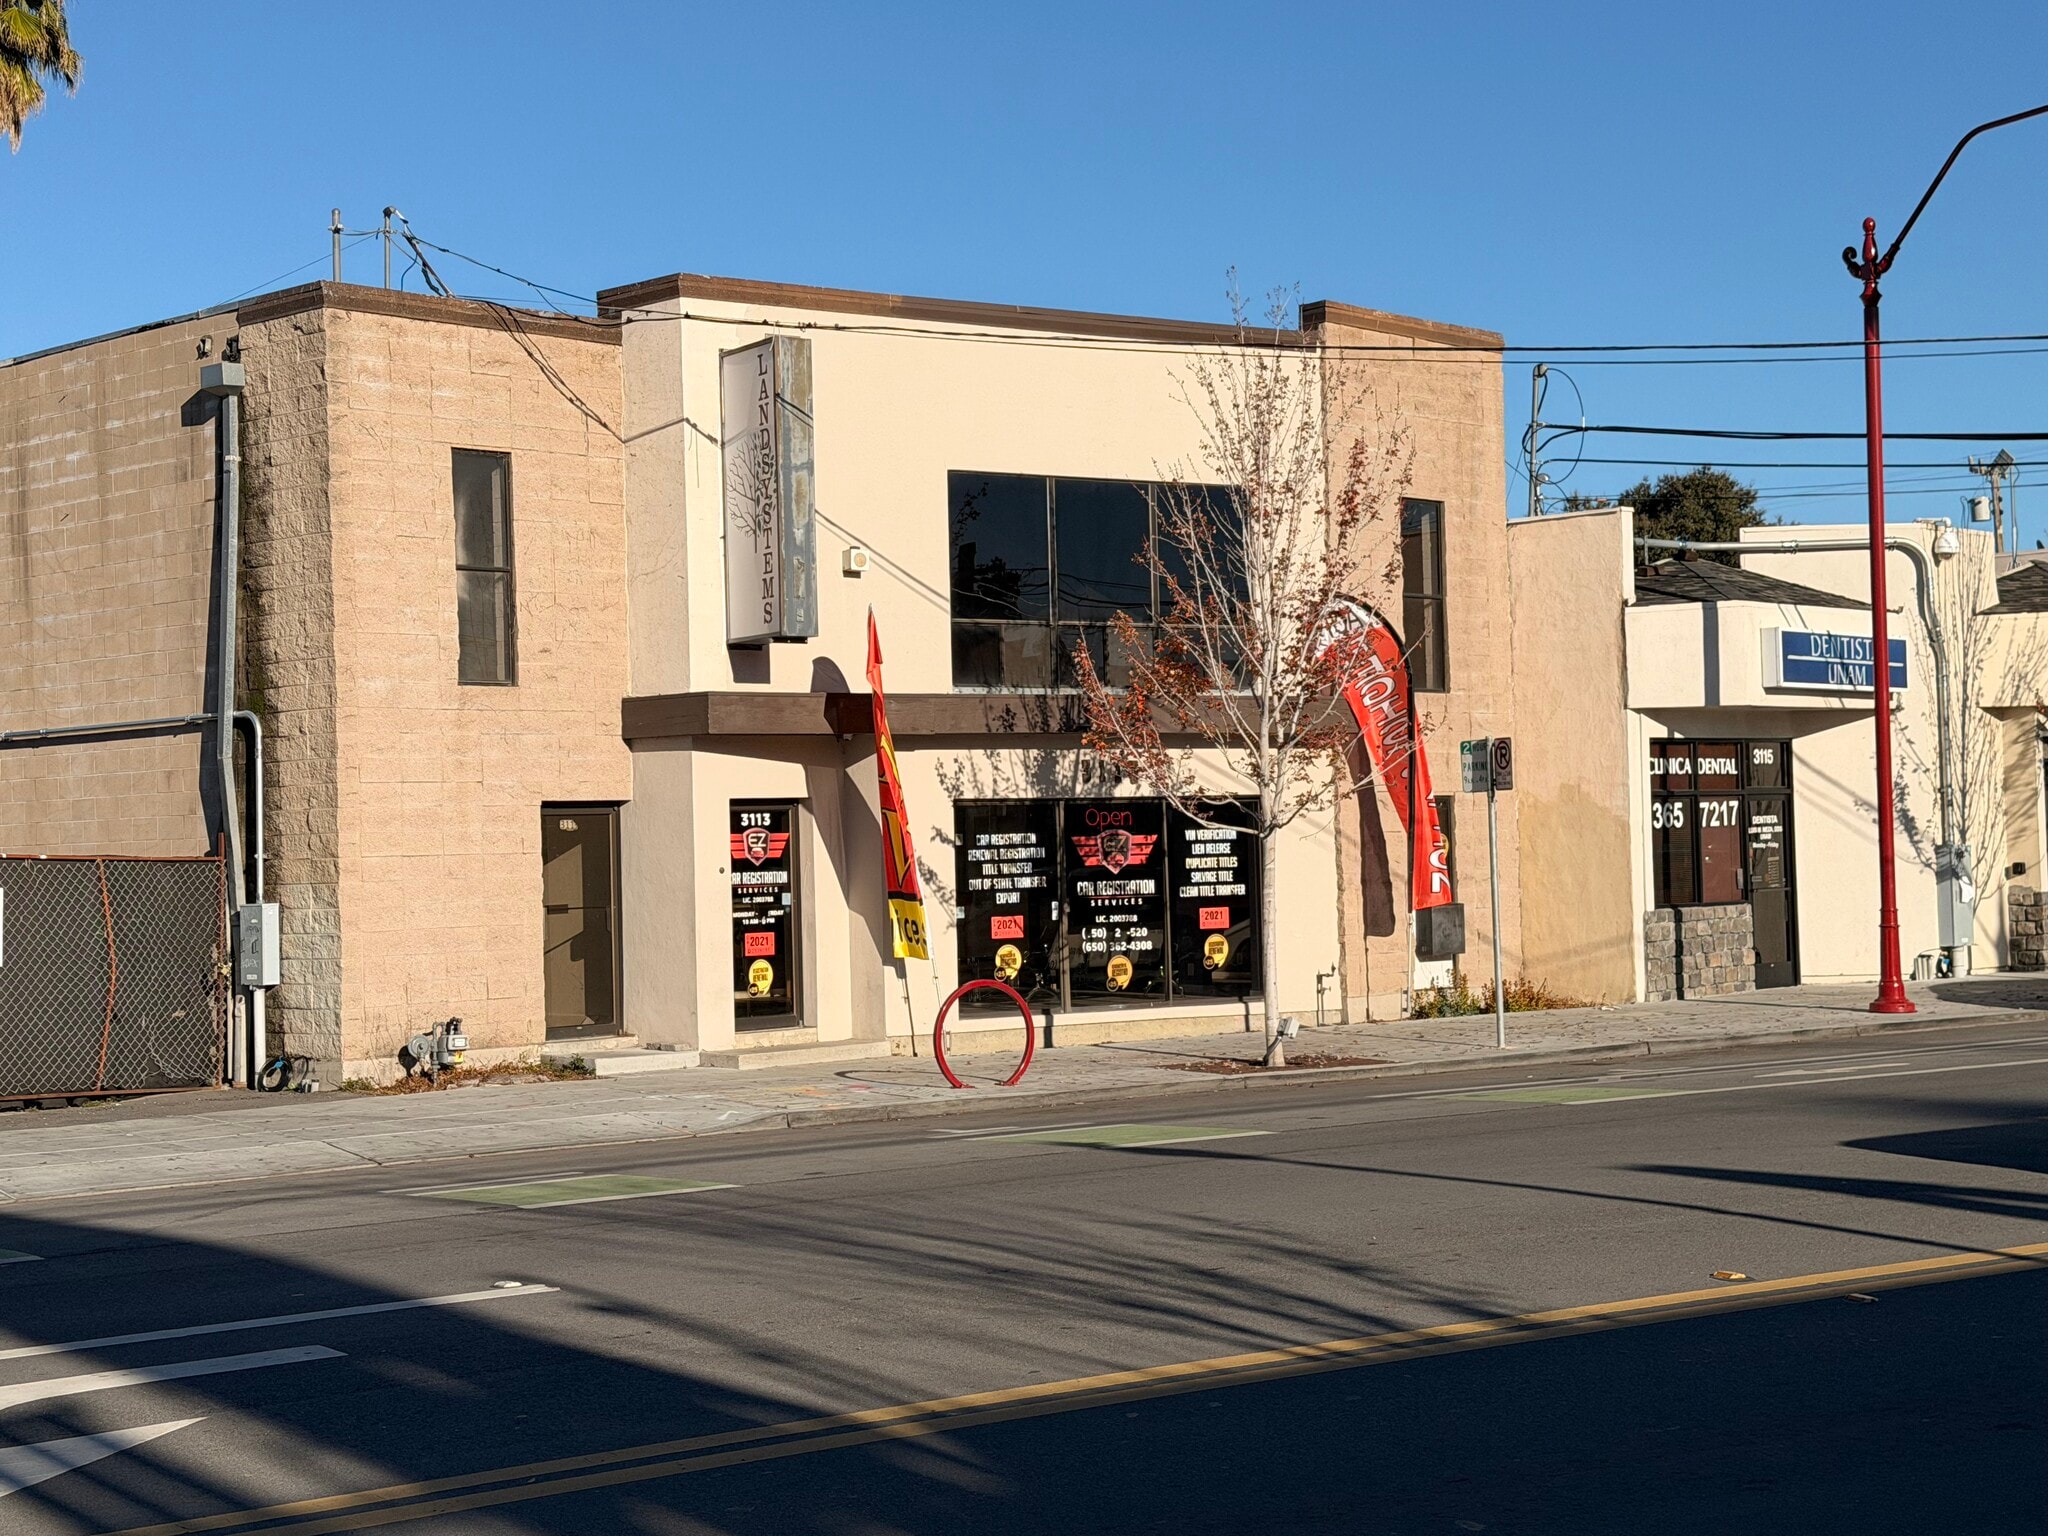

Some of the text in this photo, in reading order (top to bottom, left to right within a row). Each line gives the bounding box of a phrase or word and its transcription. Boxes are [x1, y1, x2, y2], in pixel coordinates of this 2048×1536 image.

[757, 353, 775, 625] LANDSYSTEMS
[1811, 635, 1874, 660] DENTIST
[1828, 663, 1866, 685] UNAM
[1463, 743, 1470, 754] 2
[1753, 748, 1774, 764] 3115
[1649, 757, 1738, 775] CLINICA DENTAL
[741, 813, 771, 826] 3113
[1086, 808, 1132, 831] Open
[1652, 800, 1739, 829] 365 7217
[748, 833, 766, 848] EZ
[976, 833, 1037, 846] CAR REGISTRATION
[1185, 828, 1237, 841] VIN VERIFICATION
[968, 847, 1046, 861] RENEWAL REGISTRATION
[1192, 842, 1231, 855] LIEN RELEASE
[982, 862, 1033, 875] TITLE TRANSFER
[1185, 856, 1238, 869] DUPLICATE TITLES
[731, 871, 788, 885] AR REGISTRATION
[1191, 870, 1233, 883] SALVAGE TITLE
[968, 876, 1047, 891] OUT OF STATE TRANSFER
[1077, 880, 1155, 896] CAR REGISTRATION
[1179, 884, 1246, 897] CLEAN TITLE TRANSFER
[996, 892, 1020, 904] EXPORT
[1090, 898, 1143, 907] SERVICES
[1204, 910, 1223, 920] 2021
[997, 919, 1017, 930] 2021
[750, 936, 769, 946] 2021
[1082, 940, 1153, 953] (650) 362-4308
